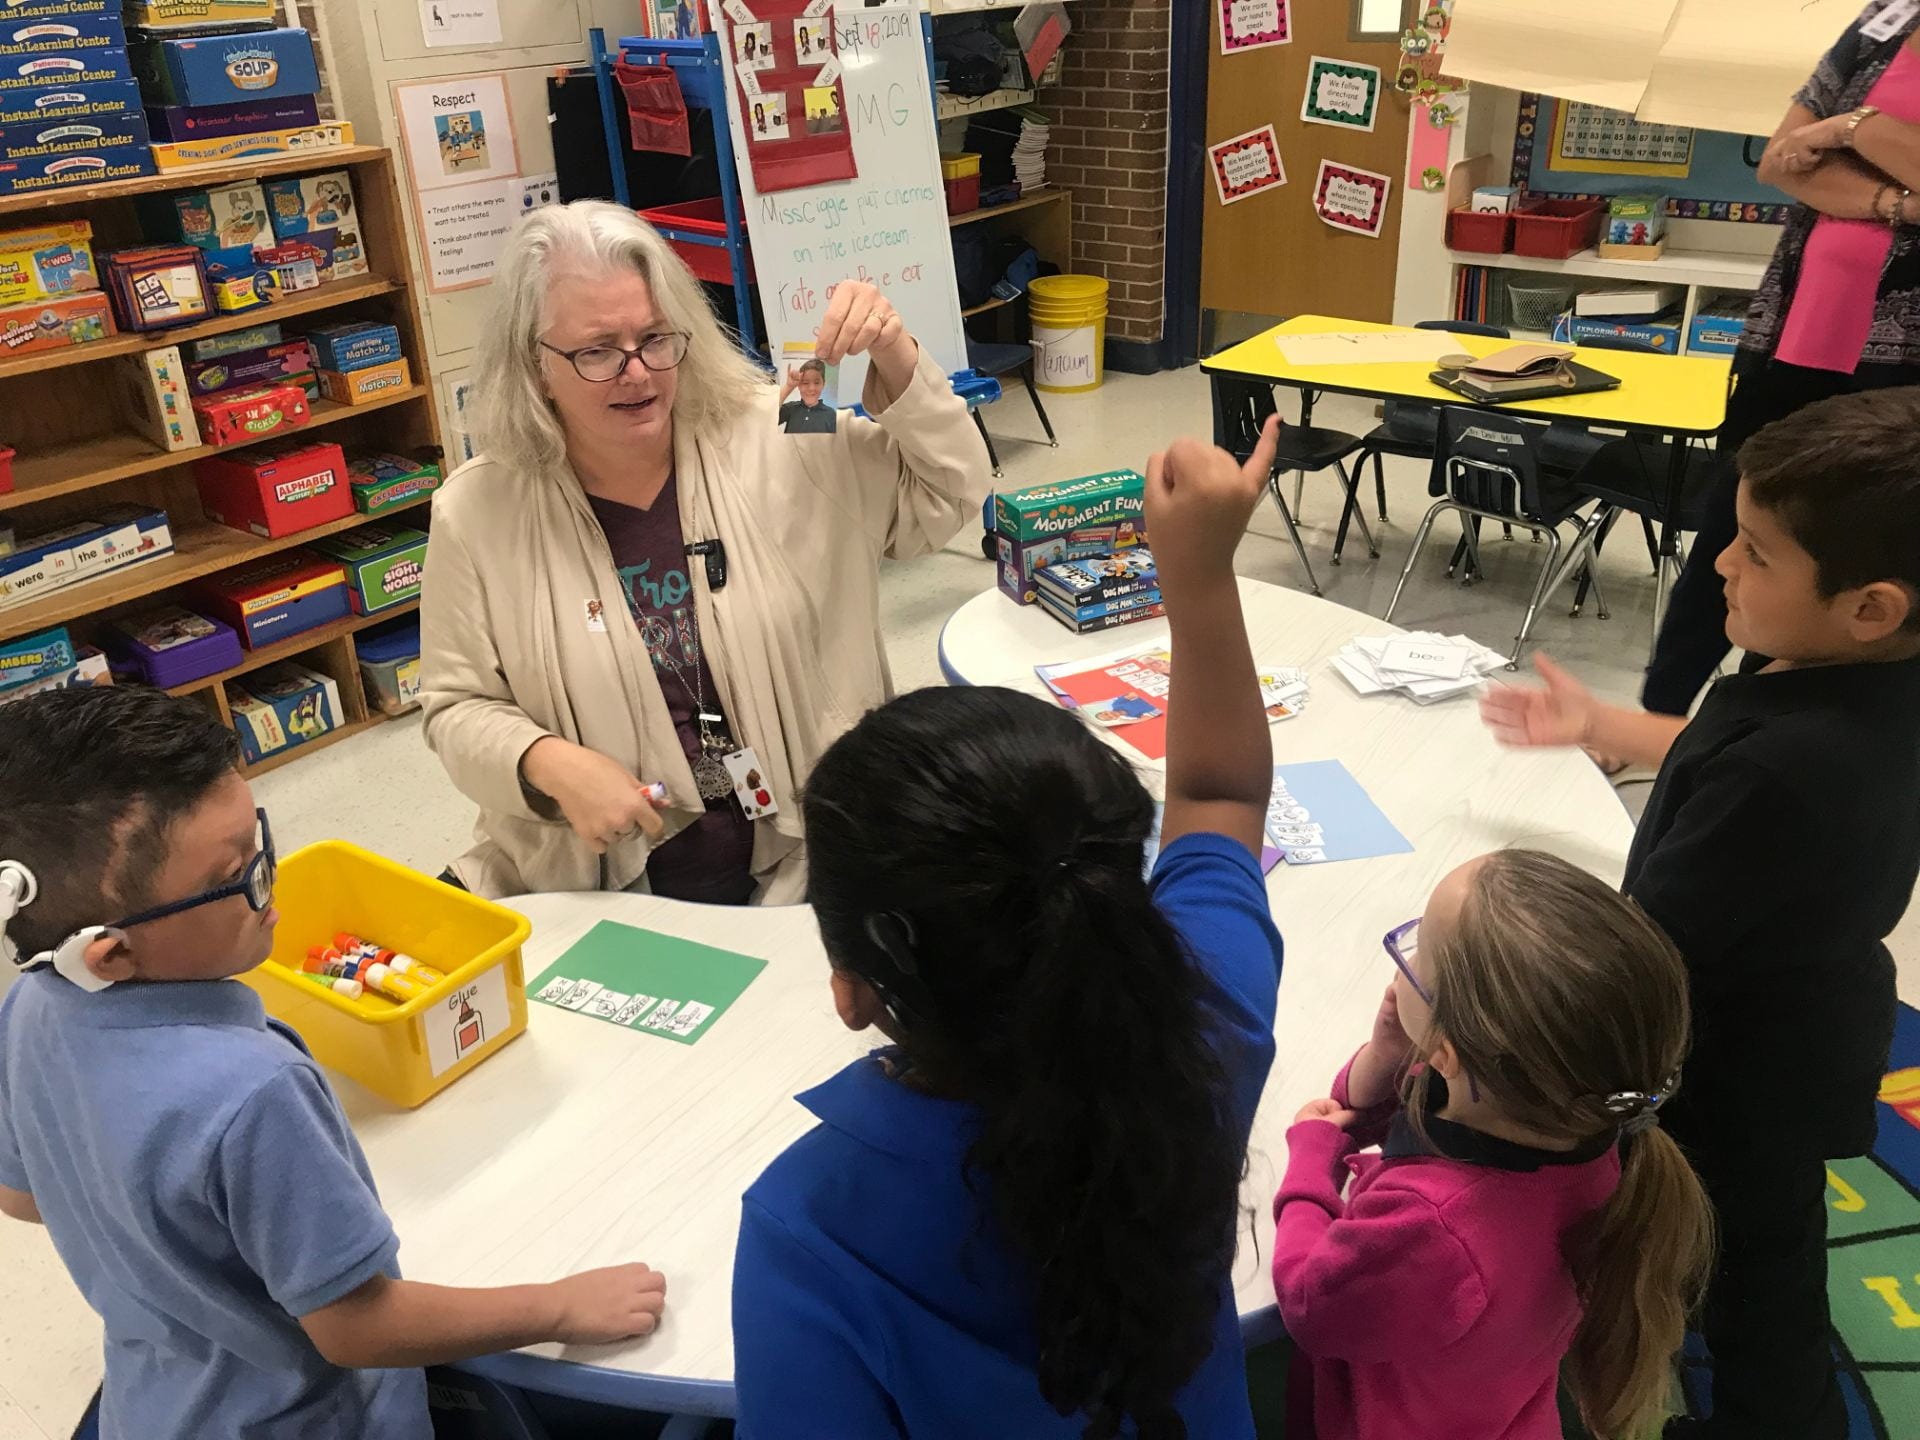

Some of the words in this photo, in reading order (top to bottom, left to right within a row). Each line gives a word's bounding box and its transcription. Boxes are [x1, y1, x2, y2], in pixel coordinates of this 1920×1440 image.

[20, 3, 69, 16] Learning
[70, 1, 105, 11] Center
[160, 6, 209, 18] SENTENCES
[26, 38, 75, 52] Learning
[75, 35, 111, 48] Center
[834, 15, 863, 62] Sept
[882, 13, 911, 38] 2019
[32, 60, 70, 69] Patterning
[234, 61, 271, 77] SOUP
[32, 72, 80, 85] Learning
[81, 69, 117, 80] Center
[1341, 81, 1360, 91] follow
[432, 92, 476, 109] Respect
[1327, 89, 1358, 100] directions
[0, 110, 41, 122] Instant
[43, 104, 90, 117] Learning
[92, 101, 125, 112] Center
[888, 83, 910, 126] G
[1616, 118, 1625, 126] 75
[6, 145, 49, 158] Instant
[49, 138, 98, 152] Learning
[99, 134, 134, 146] Center
[1614, 133, 1623, 141] 85
[1639, 134, 1648, 142] 87
[1664, 135, 1674, 143] 89
[1677, 136, 1688, 144] 90
[1661, 150, 1671, 158] 99
[1673, 150, 1687, 159] 100
[12, 176, 55, 189] Instant
[56, 168, 105, 183] Learning
[106, 164, 141, 177] Center
[432, 206, 449, 214] Treat
[452, 202, 471, 211] others
[484, 199, 494, 207] way
[495, 197, 505, 206] you
[857, 190, 879, 226] put
[885, 186, 934, 206] cherries
[1698, 202, 1710, 218] 3
[1729, 203, 1742, 221] 5
[1744, 203, 1759, 221] 6
[435, 218, 449, 226] want
[467, 211, 490, 221] treated
[438, 237, 454, 245] Think
[456, 233, 472, 241] about
[473, 230, 489, 239] other
[440, 248, 463, 258] feelings
[793, 247, 813, 264] on
[819, 238, 846, 260] the
[51, 254, 73, 267] was
[443, 267, 454, 276] Use
[456, 264, 469, 275] good
[470, 260, 494, 269] manners
[779, 277, 816, 323] Kate
[7, 331, 34, 348] Words
[1576, 325, 1618, 337] EXPLORING
[1621, 330, 1650, 341] SHAPES
[346, 344, 391, 360] Match-up
[360, 376, 402, 393] Match-up
[262, 404, 273, 414] A
[278, 472, 332, 498] ALPHABET
[1016, 480, 1098, 501] MOVEMENT
[1101, 474, 1137, 484] FUN
[1033, 500, 1111, 531] MOVEMENT
[1115, 496, 1143, 511] FUN
[1120, 522, 1133, 532] 50
[15, 571, 44, 589] were
[54, 558, 65, 568] in
[78, 548, 98, 563] the
[383, 562, 419, 582] SIGHT
[383, 574, 422, 594] WORDS
[1103, 587, 1117, 599] DOG
[1118, 585, 1131, 595] MAN
[1105, 601, 1119, 611] DOG
[253, 612, 288, 629] Miniatures
[1105, 615, 1118, 626] DOG
[448, 983, 479, 1011] Glue
